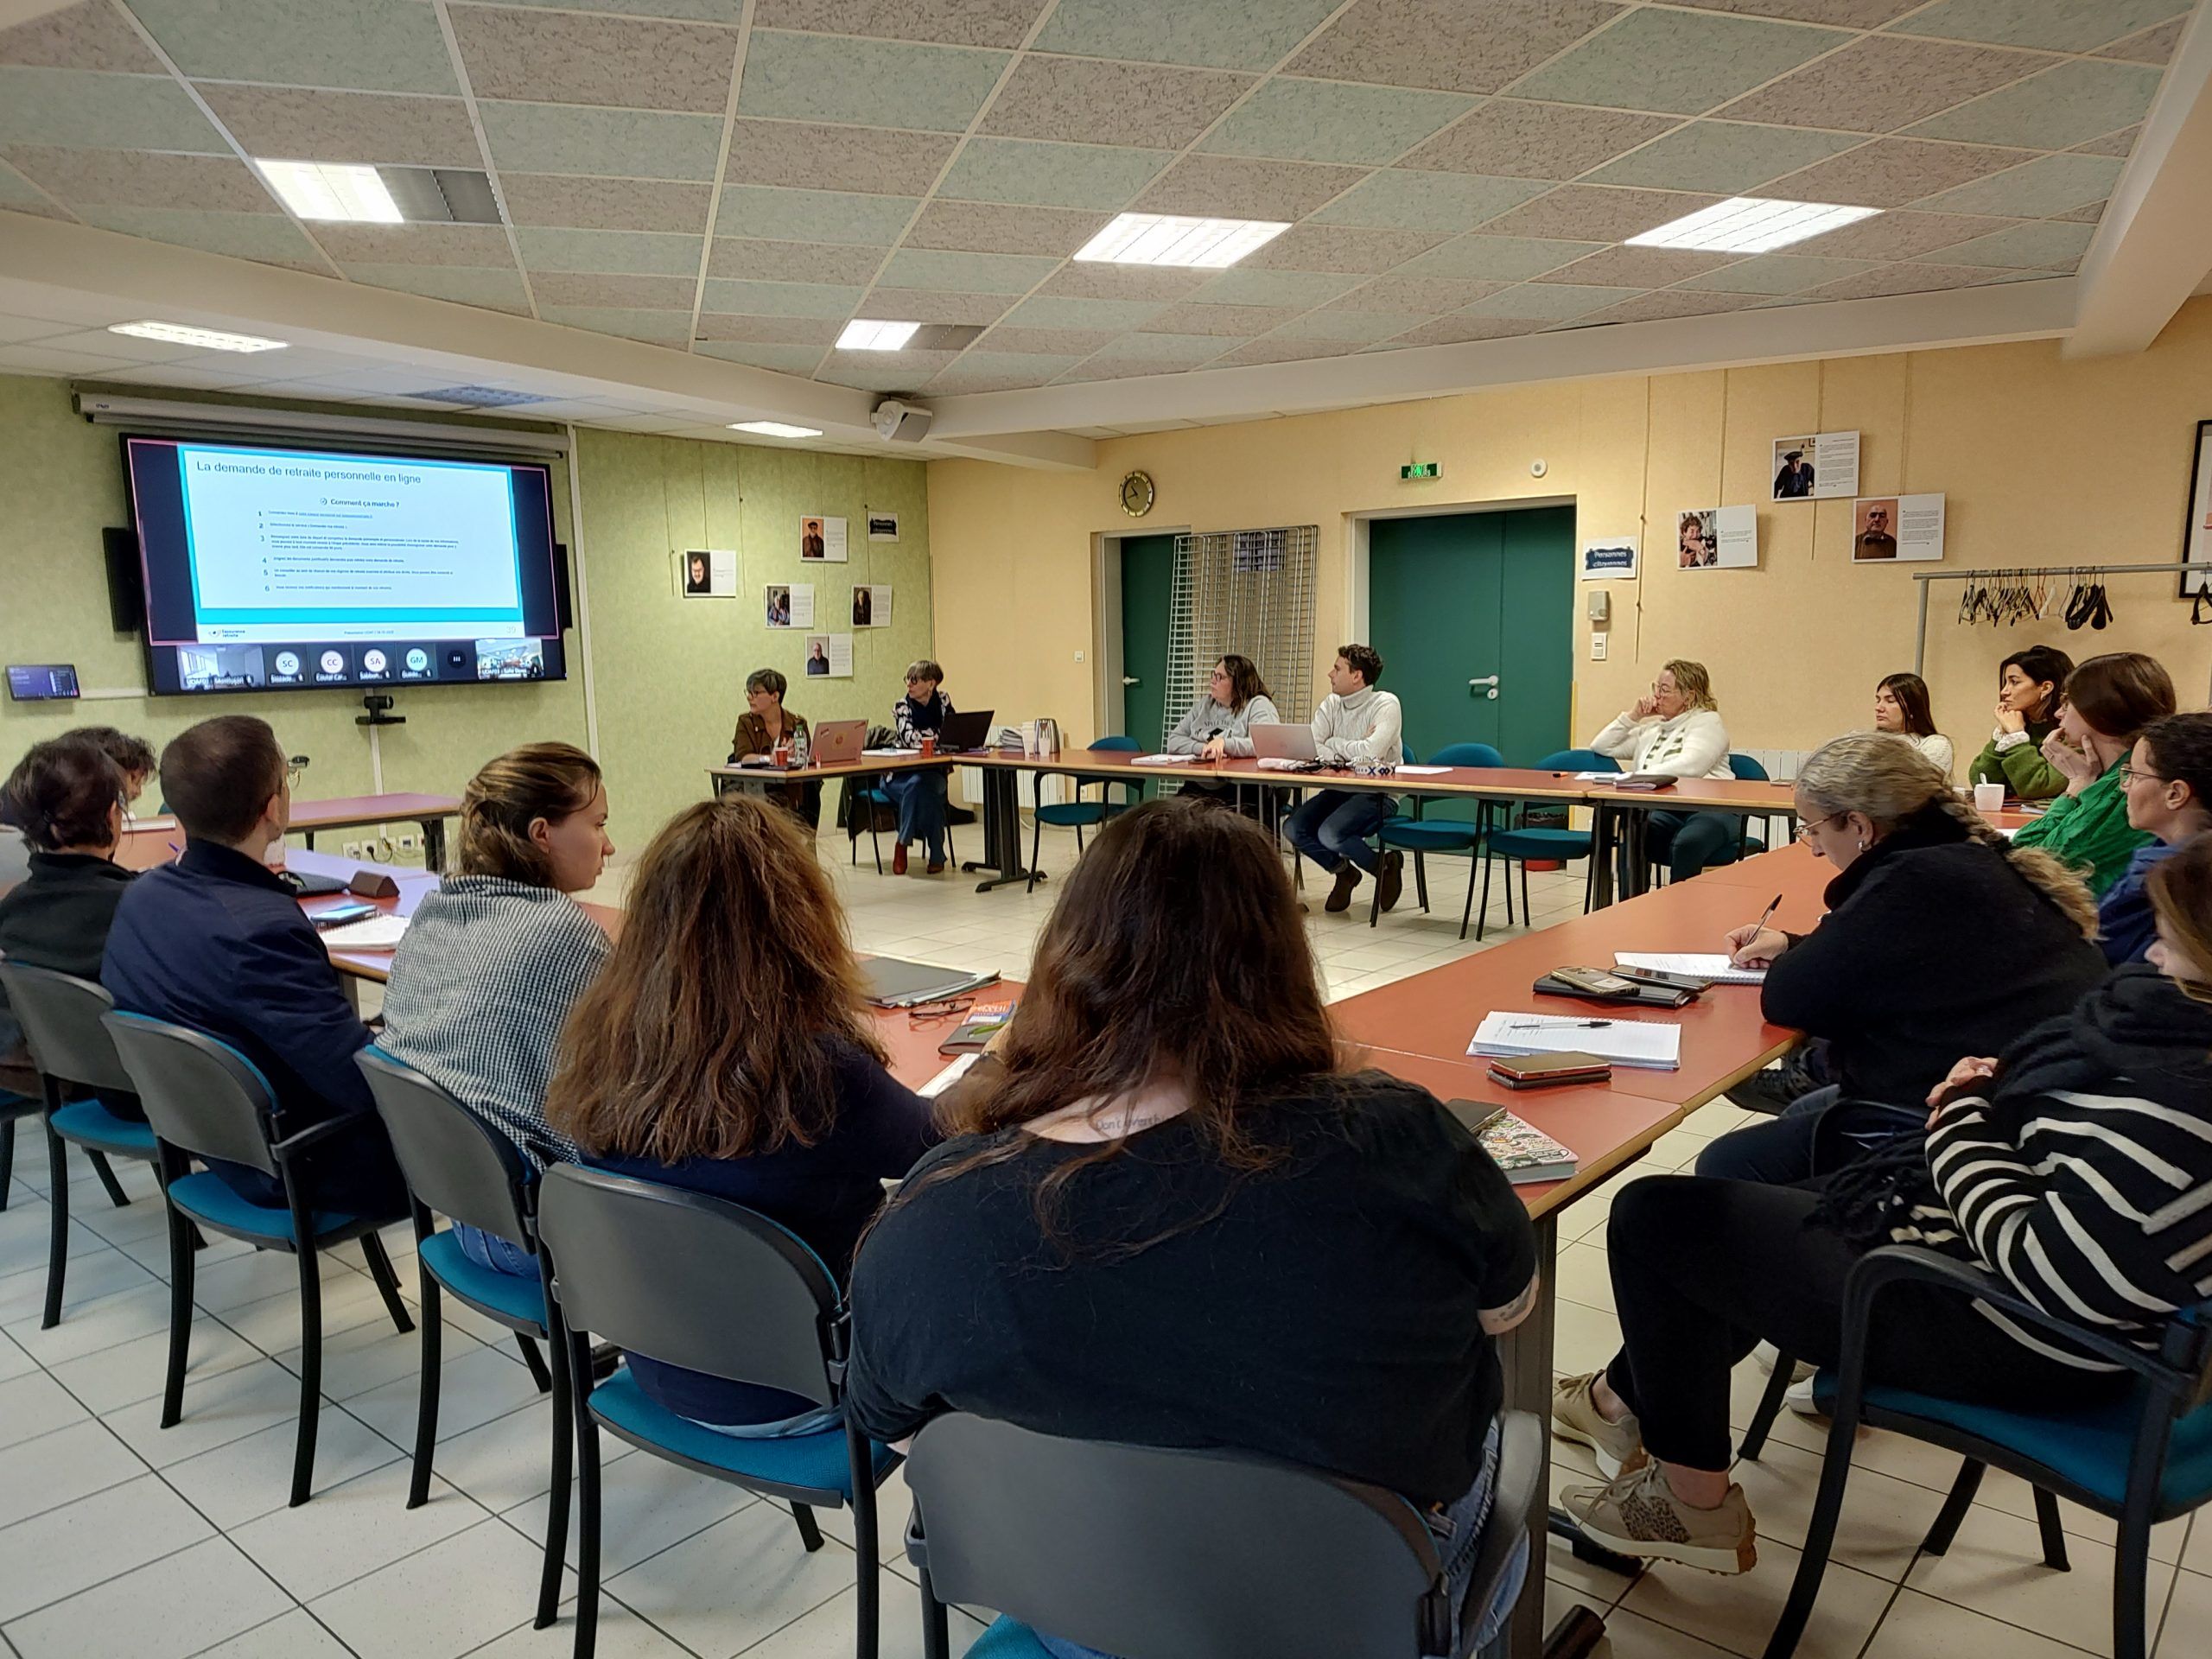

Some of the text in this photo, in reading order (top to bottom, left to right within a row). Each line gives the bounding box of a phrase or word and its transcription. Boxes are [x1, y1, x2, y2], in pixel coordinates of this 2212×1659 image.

[196, 461, 421, 485] La demande de retraite personnelle en ligne
[1594, 550, 1627, 559] Personnes
